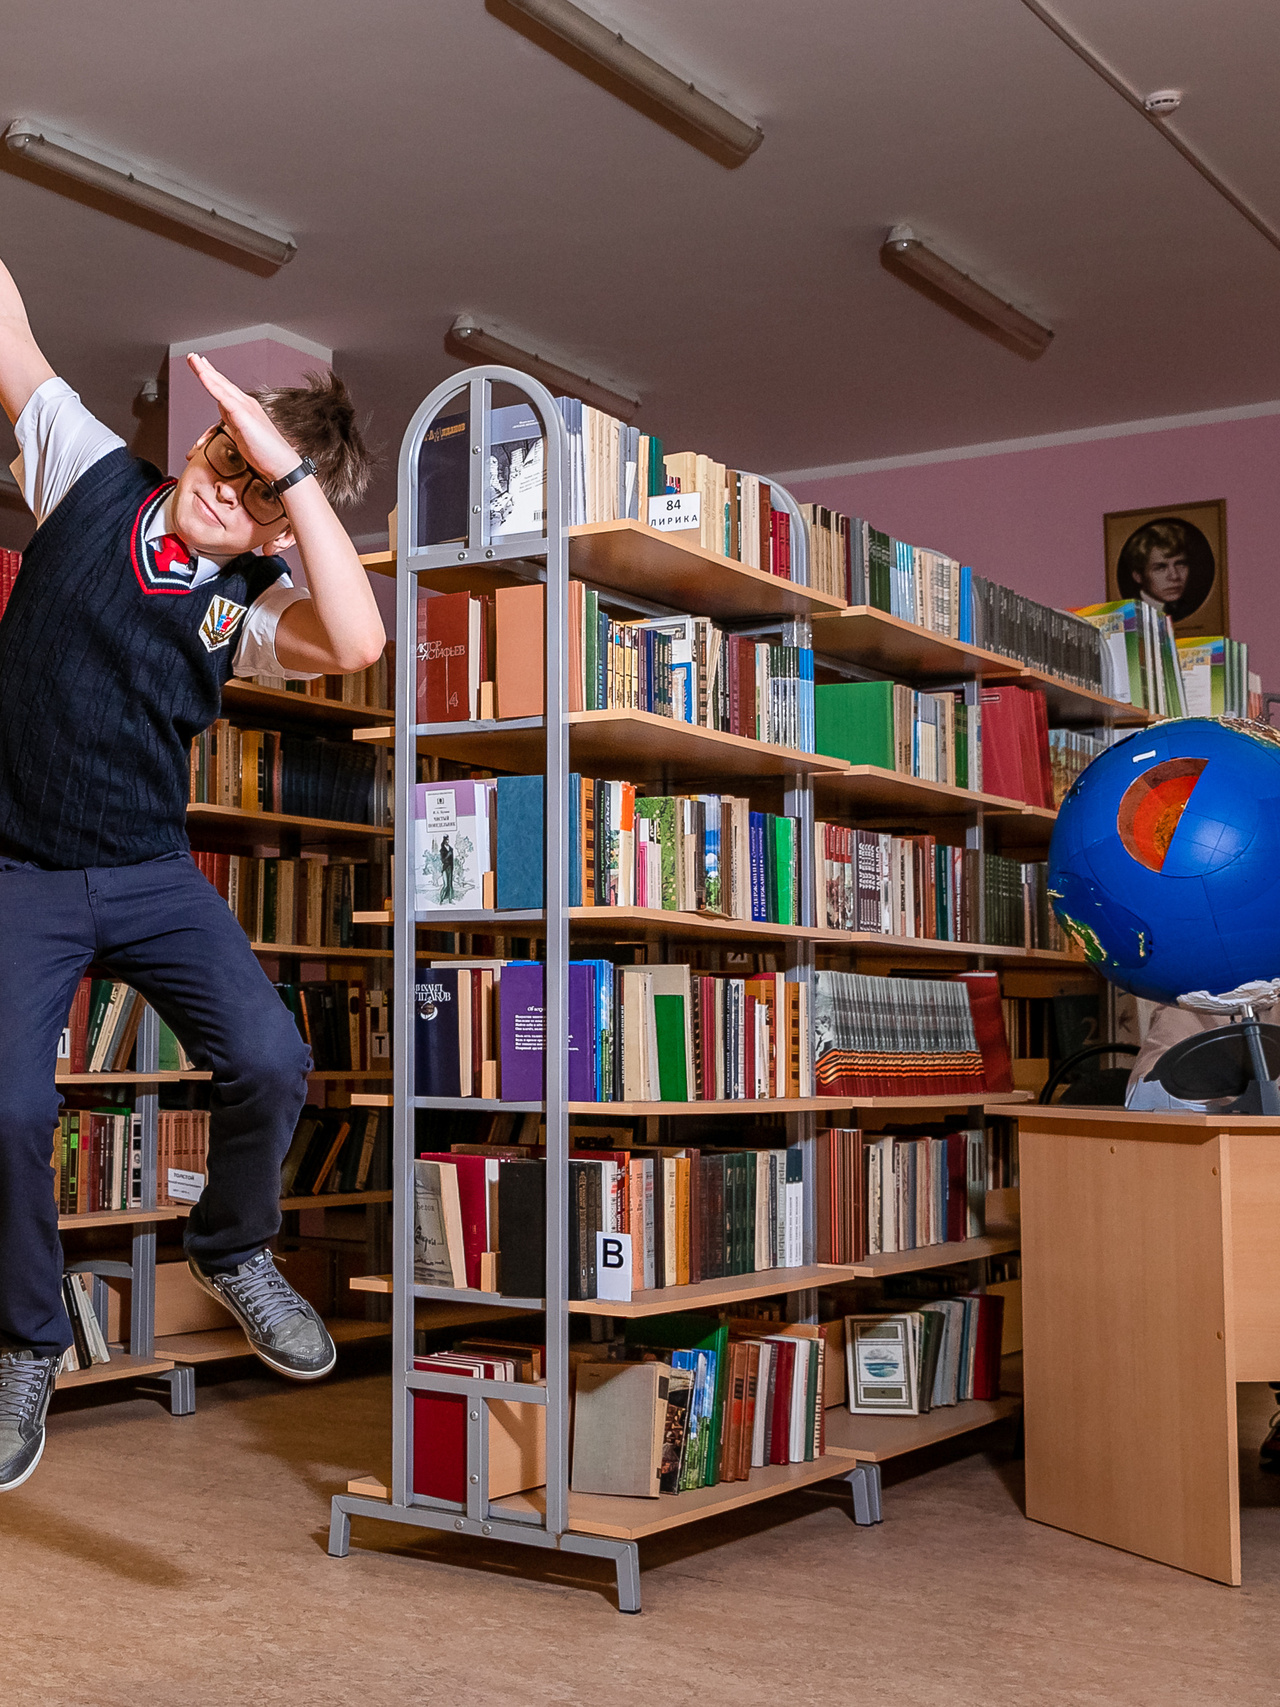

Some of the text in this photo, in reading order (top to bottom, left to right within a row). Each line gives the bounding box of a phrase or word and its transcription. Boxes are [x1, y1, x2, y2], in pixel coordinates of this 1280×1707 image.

[666, 500, 681, 511] 84
[650, 515, 698, 527] ЛИРИКА
[449, 691, 459, 707] 4
[375, 1036, 385, 1054] Т
[602, 1238, 624, 1269] В
